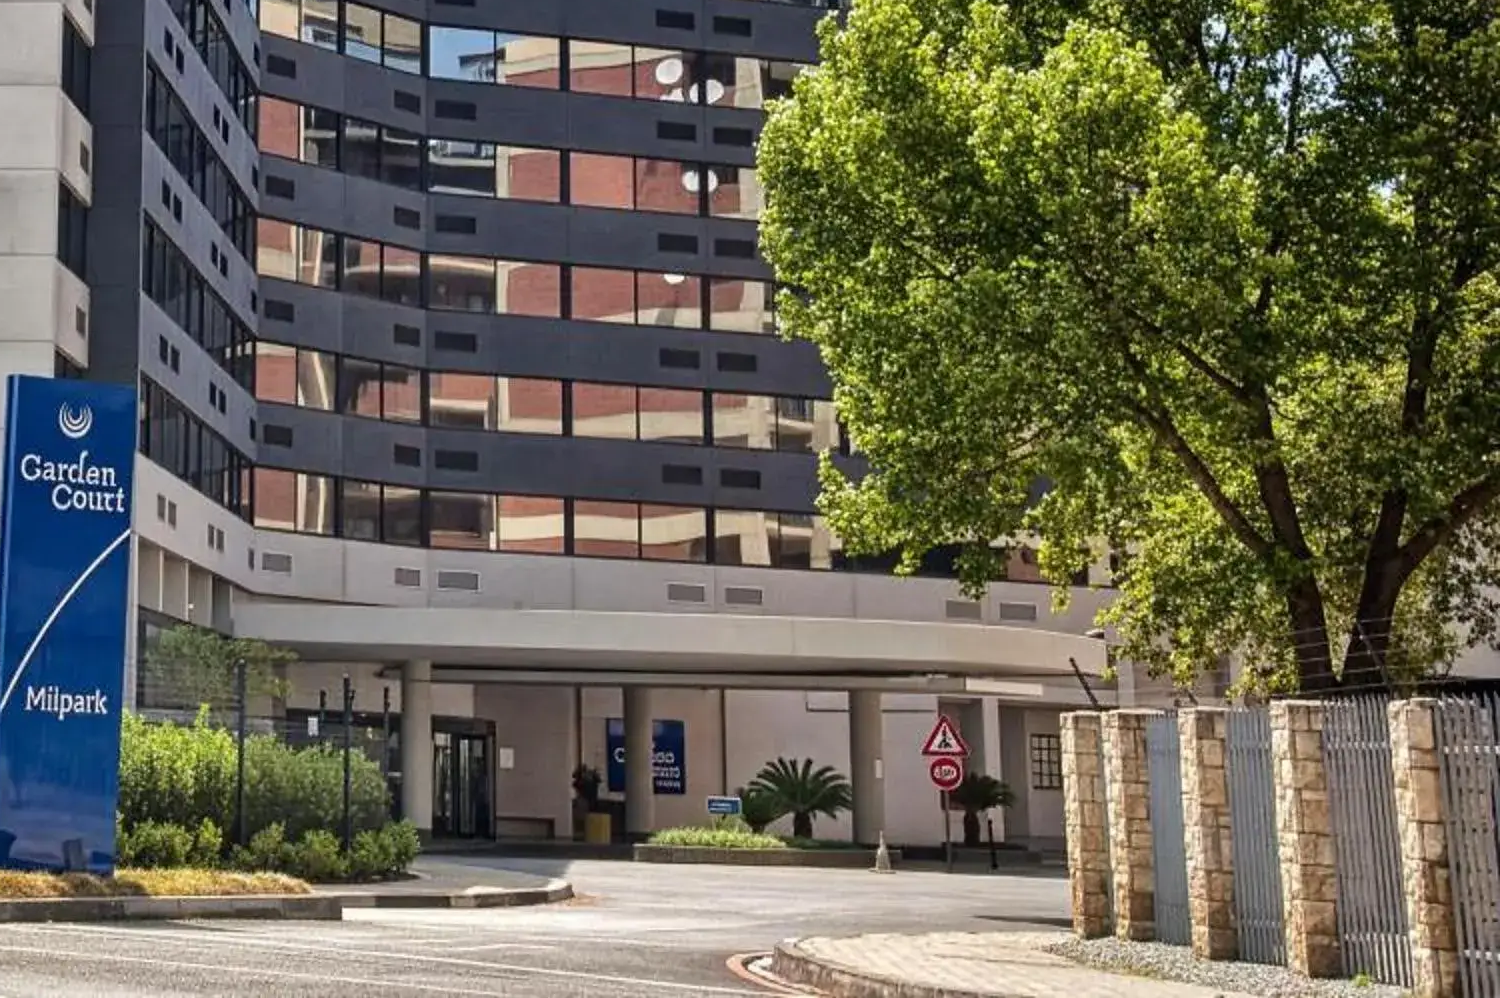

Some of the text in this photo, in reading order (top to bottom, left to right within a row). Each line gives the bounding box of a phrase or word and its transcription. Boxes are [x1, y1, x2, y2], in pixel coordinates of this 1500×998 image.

[20, 449, 118, 487] Garden
[51, 484, 126, 513] Court
[25, 686, 108, 722] Milpark
